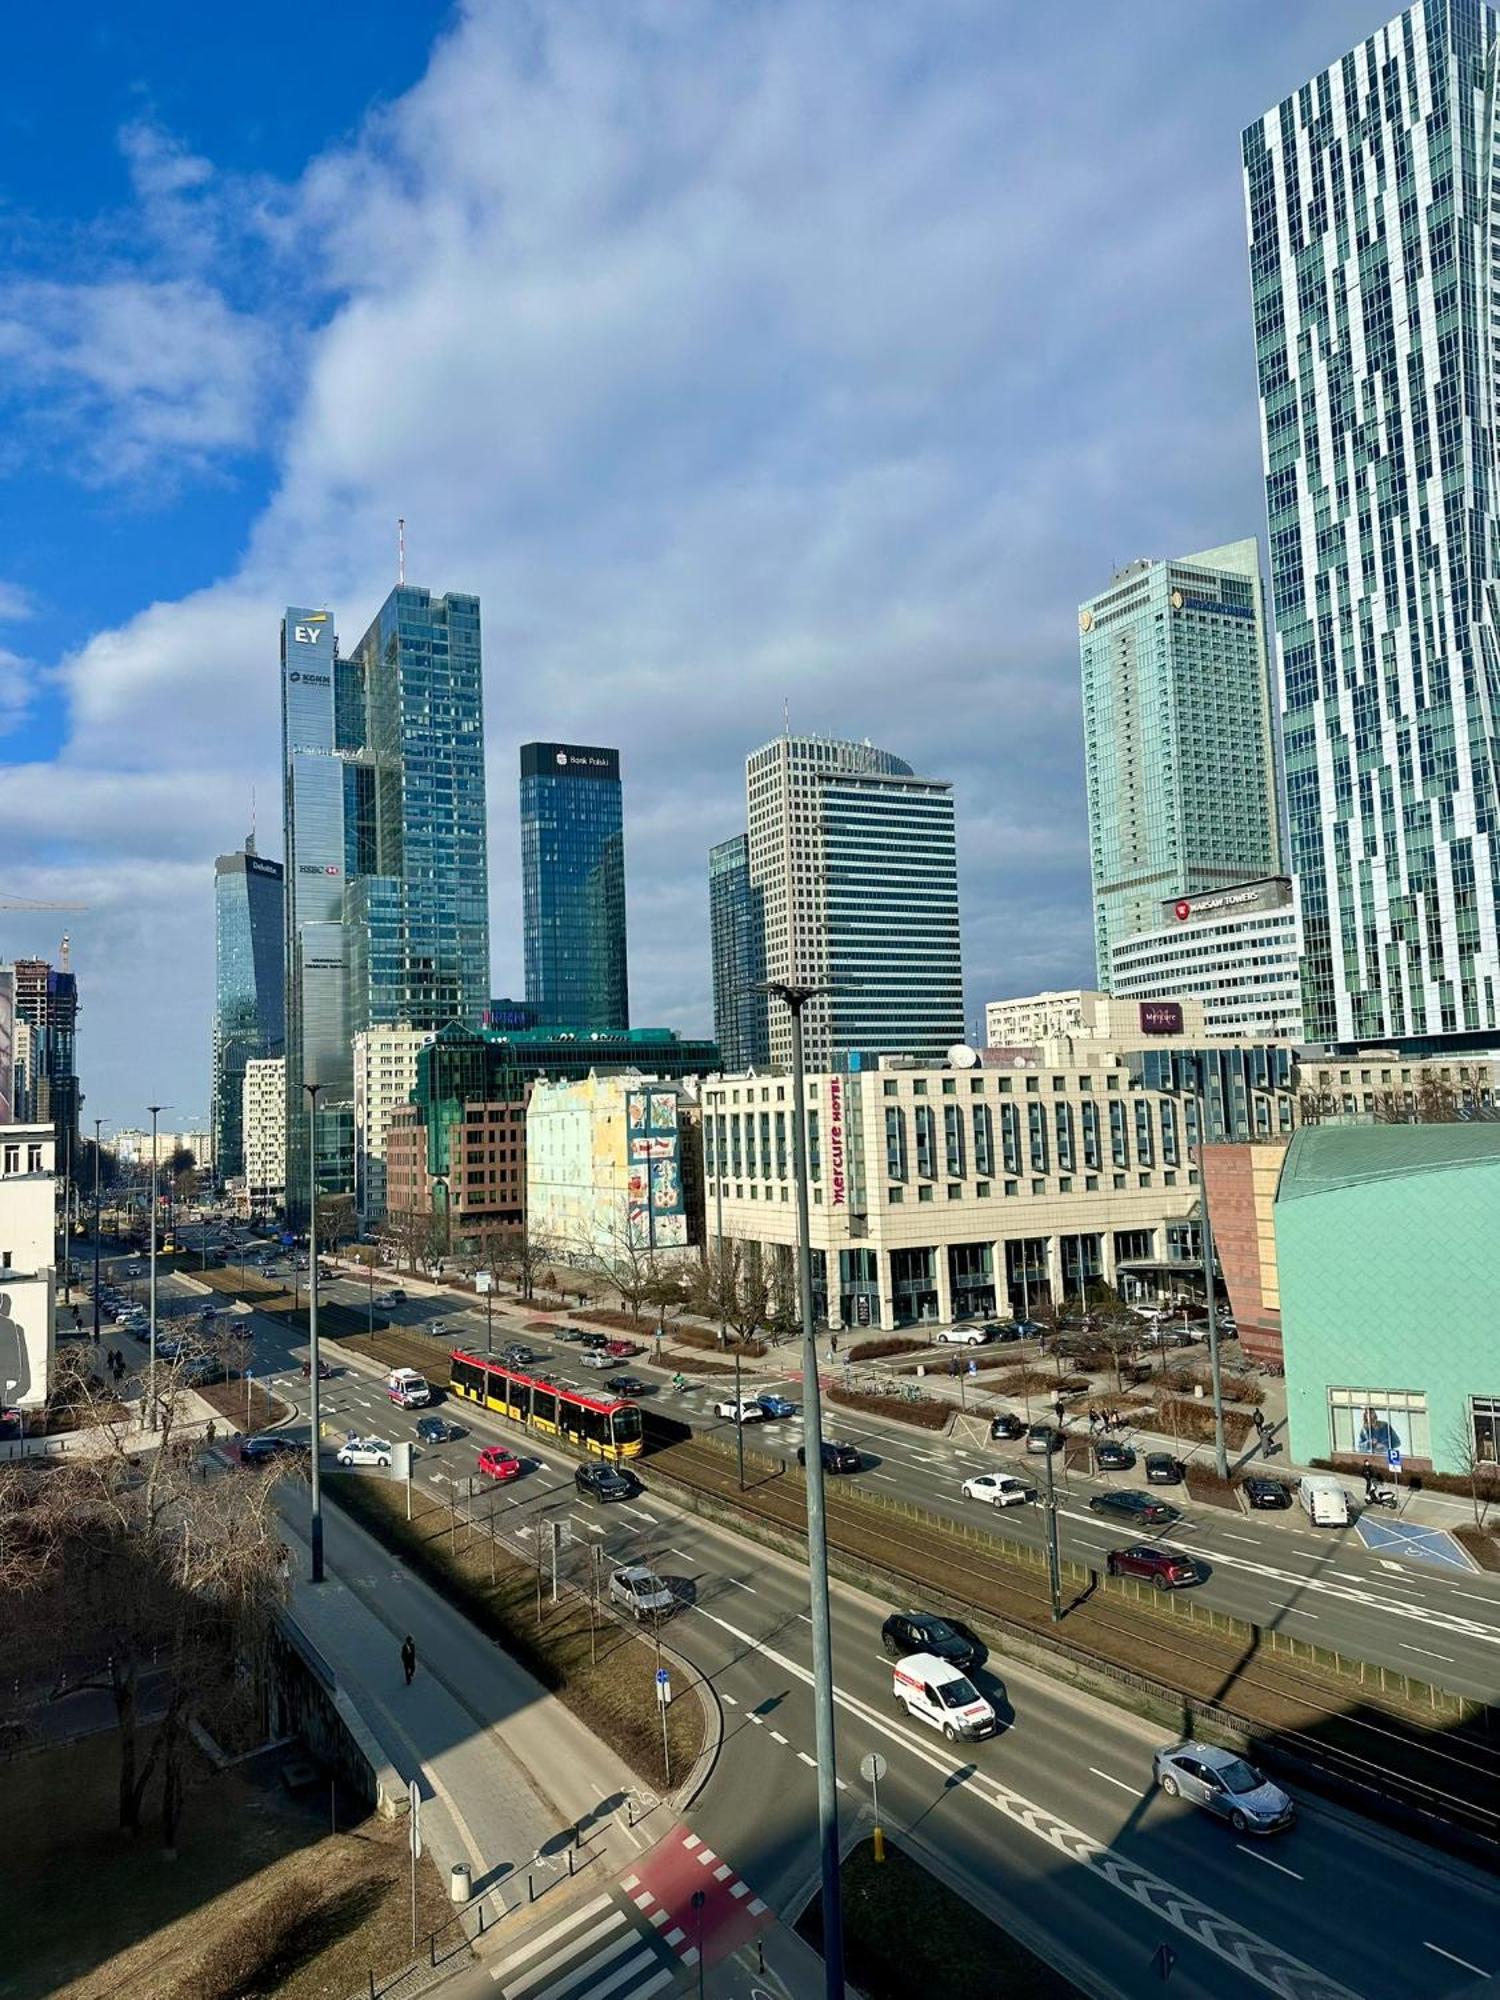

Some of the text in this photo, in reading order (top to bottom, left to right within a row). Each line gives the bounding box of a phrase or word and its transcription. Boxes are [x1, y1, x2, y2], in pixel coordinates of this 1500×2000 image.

[295, 626, 321, 644] EY
[570, 755, 588, 765] Bank
[1190, 892, 1259, 912] WARSAW TOWERS
[831, 1076, 844, 1122] HOTEL
